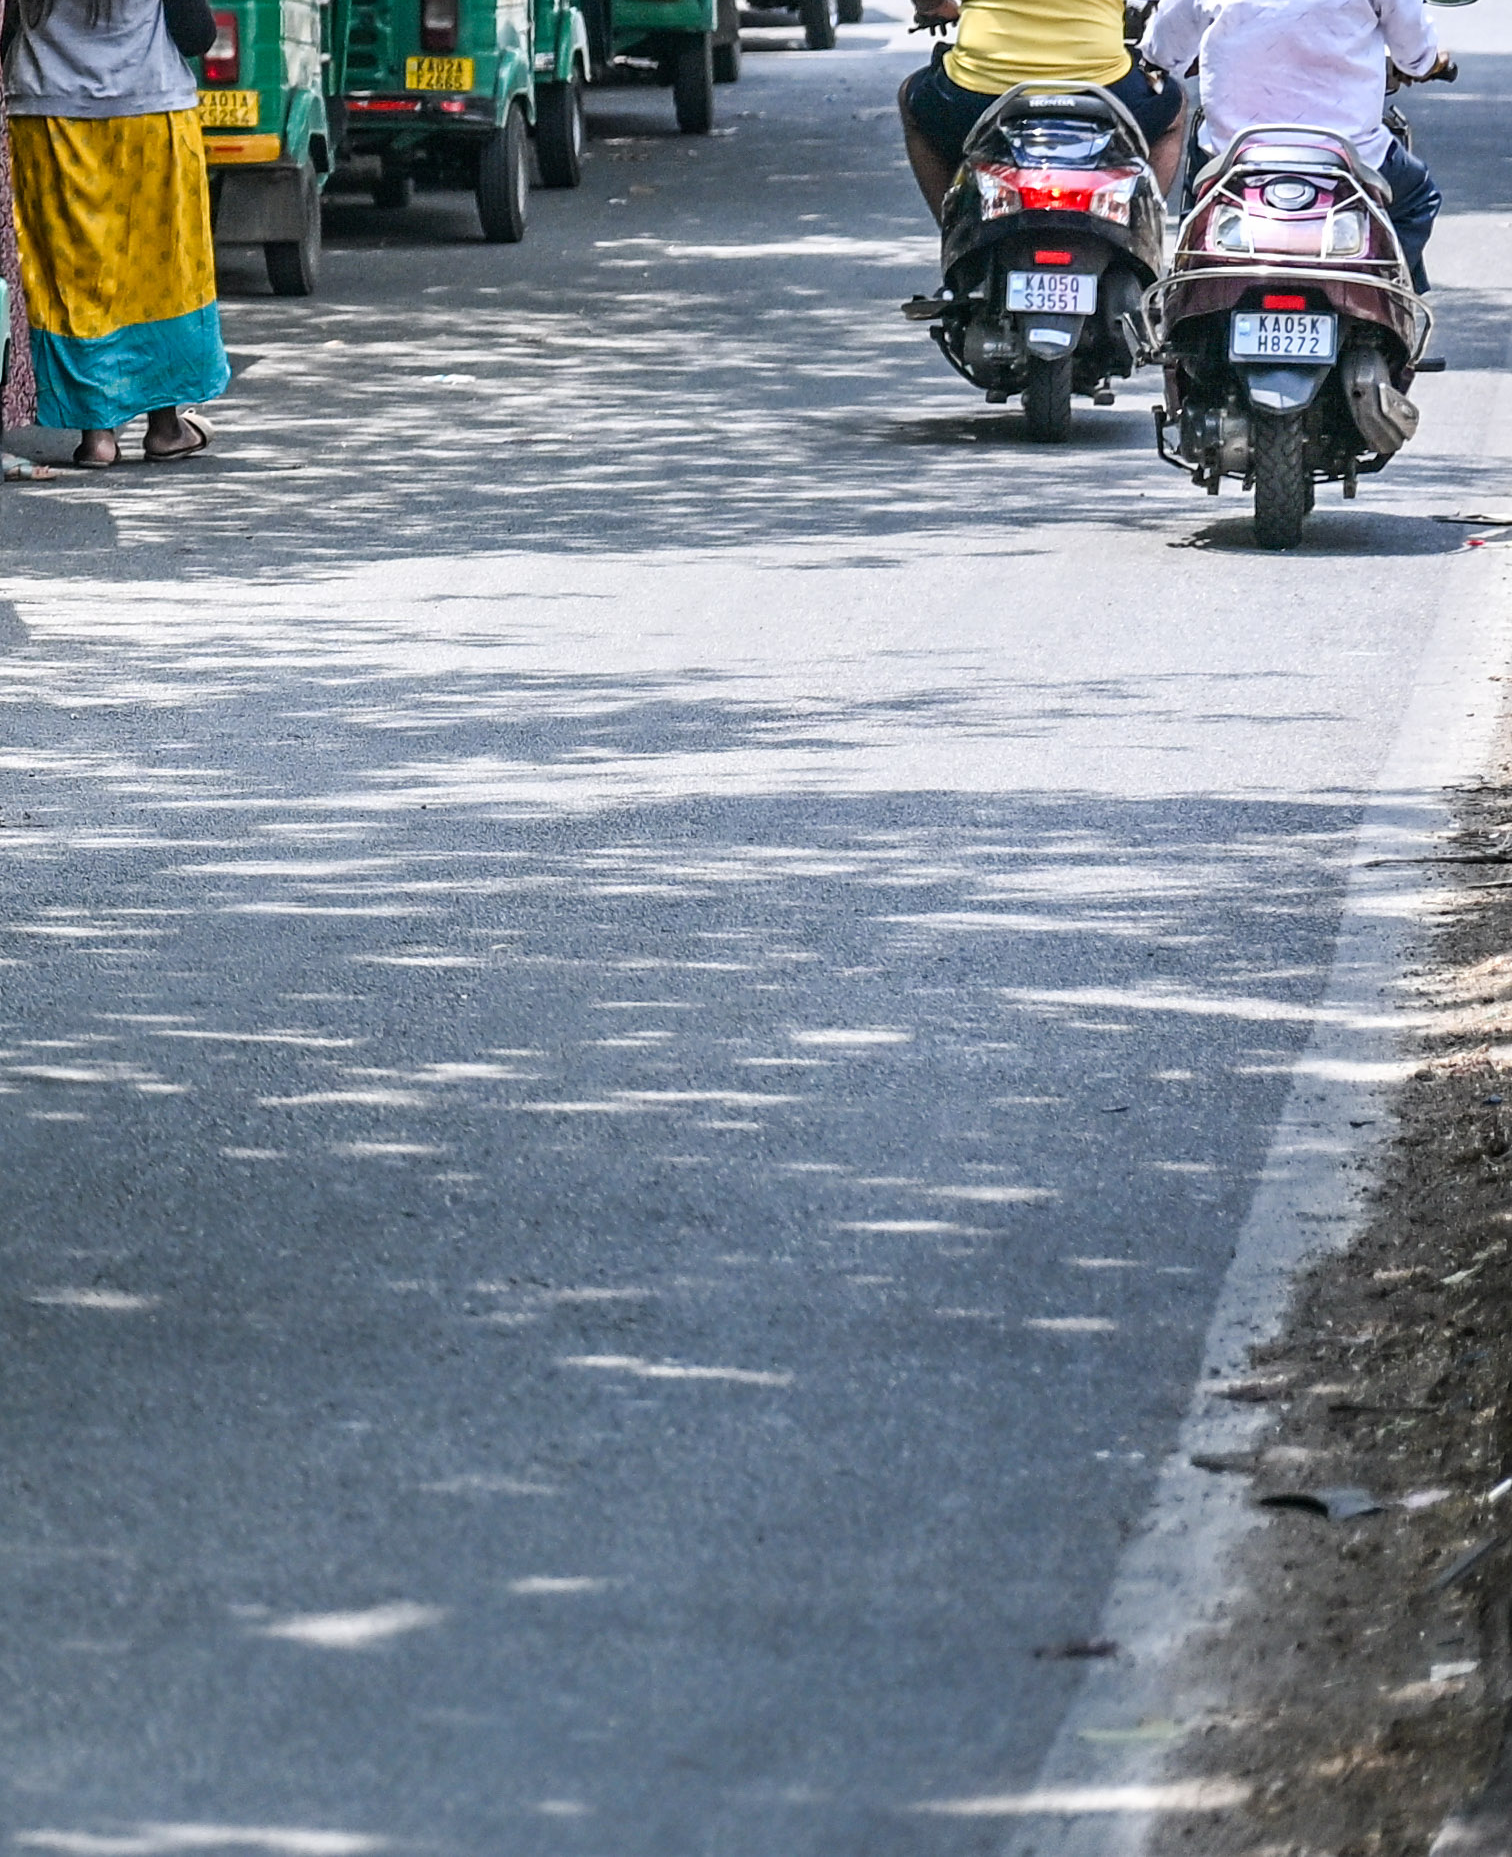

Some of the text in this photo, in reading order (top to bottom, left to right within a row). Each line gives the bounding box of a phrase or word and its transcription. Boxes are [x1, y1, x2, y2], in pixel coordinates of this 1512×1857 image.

[1024, 292, 1079, 311] S3551
[1259, 315, 1320, 335] KA05K
[1258, 335, 1320, 354] H8272
